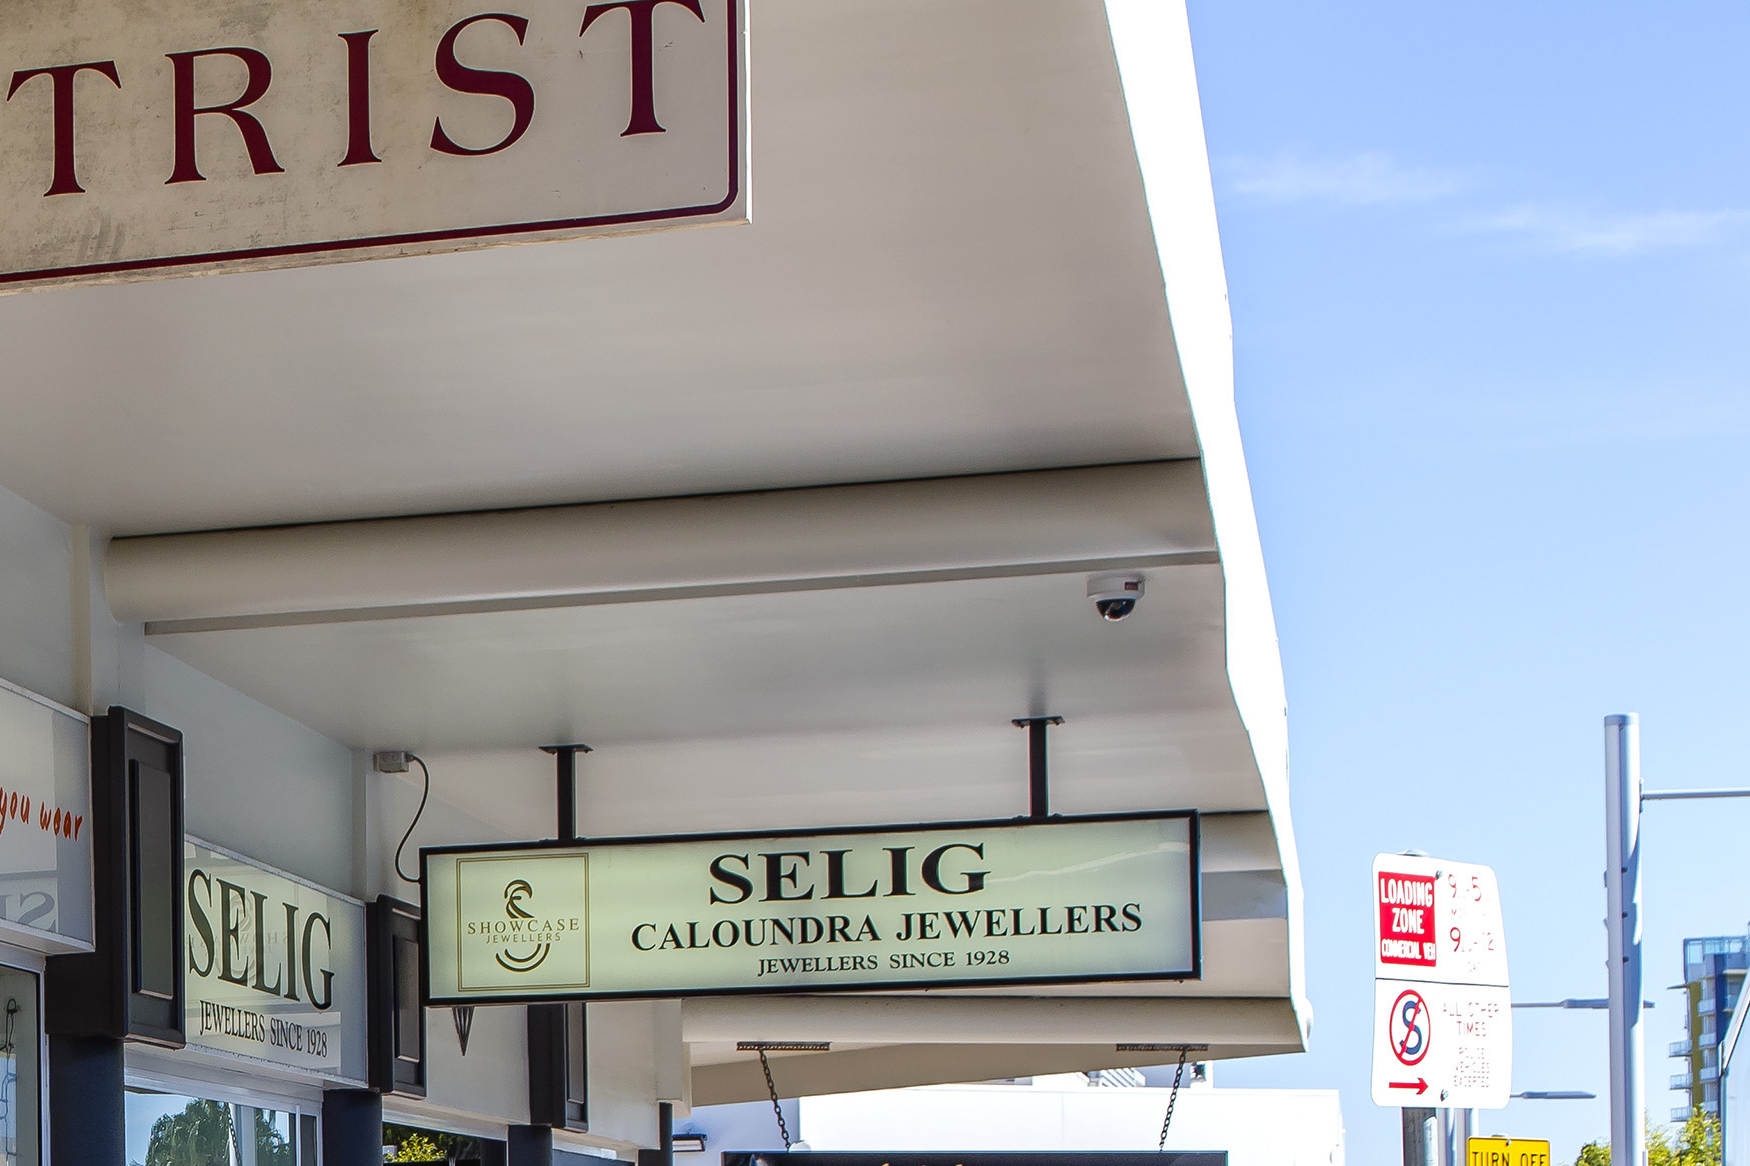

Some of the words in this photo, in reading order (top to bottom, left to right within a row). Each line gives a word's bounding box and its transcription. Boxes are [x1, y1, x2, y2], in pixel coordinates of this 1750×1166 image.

[40, 801, 83, 841] wear
[710, 843, 991, 905] SELIG
[1380, 878, 1433, 907] LOADING
[468, 918, 579, 935] SHOWCASE
[486, 931, 562, 944] JEWELLERS
[631, 914, 882, 951] CALOUNDRA
[896, 903, 1143, 941] JEWELLERS
[1392, 907, 1425, 934] ZONE
[188, 869, 335, 1010] SELIG
[758, 955, 879, 977] JEWELLERS
[890, 952, 955, 968] SINCE
[966, 950, 1010, 966] 1928
[200, 1000, 265, 1042] JEWELLERS
[271, 1017, 302, 1051] SINCE
[307, 1029, 327, 1057] 1928
